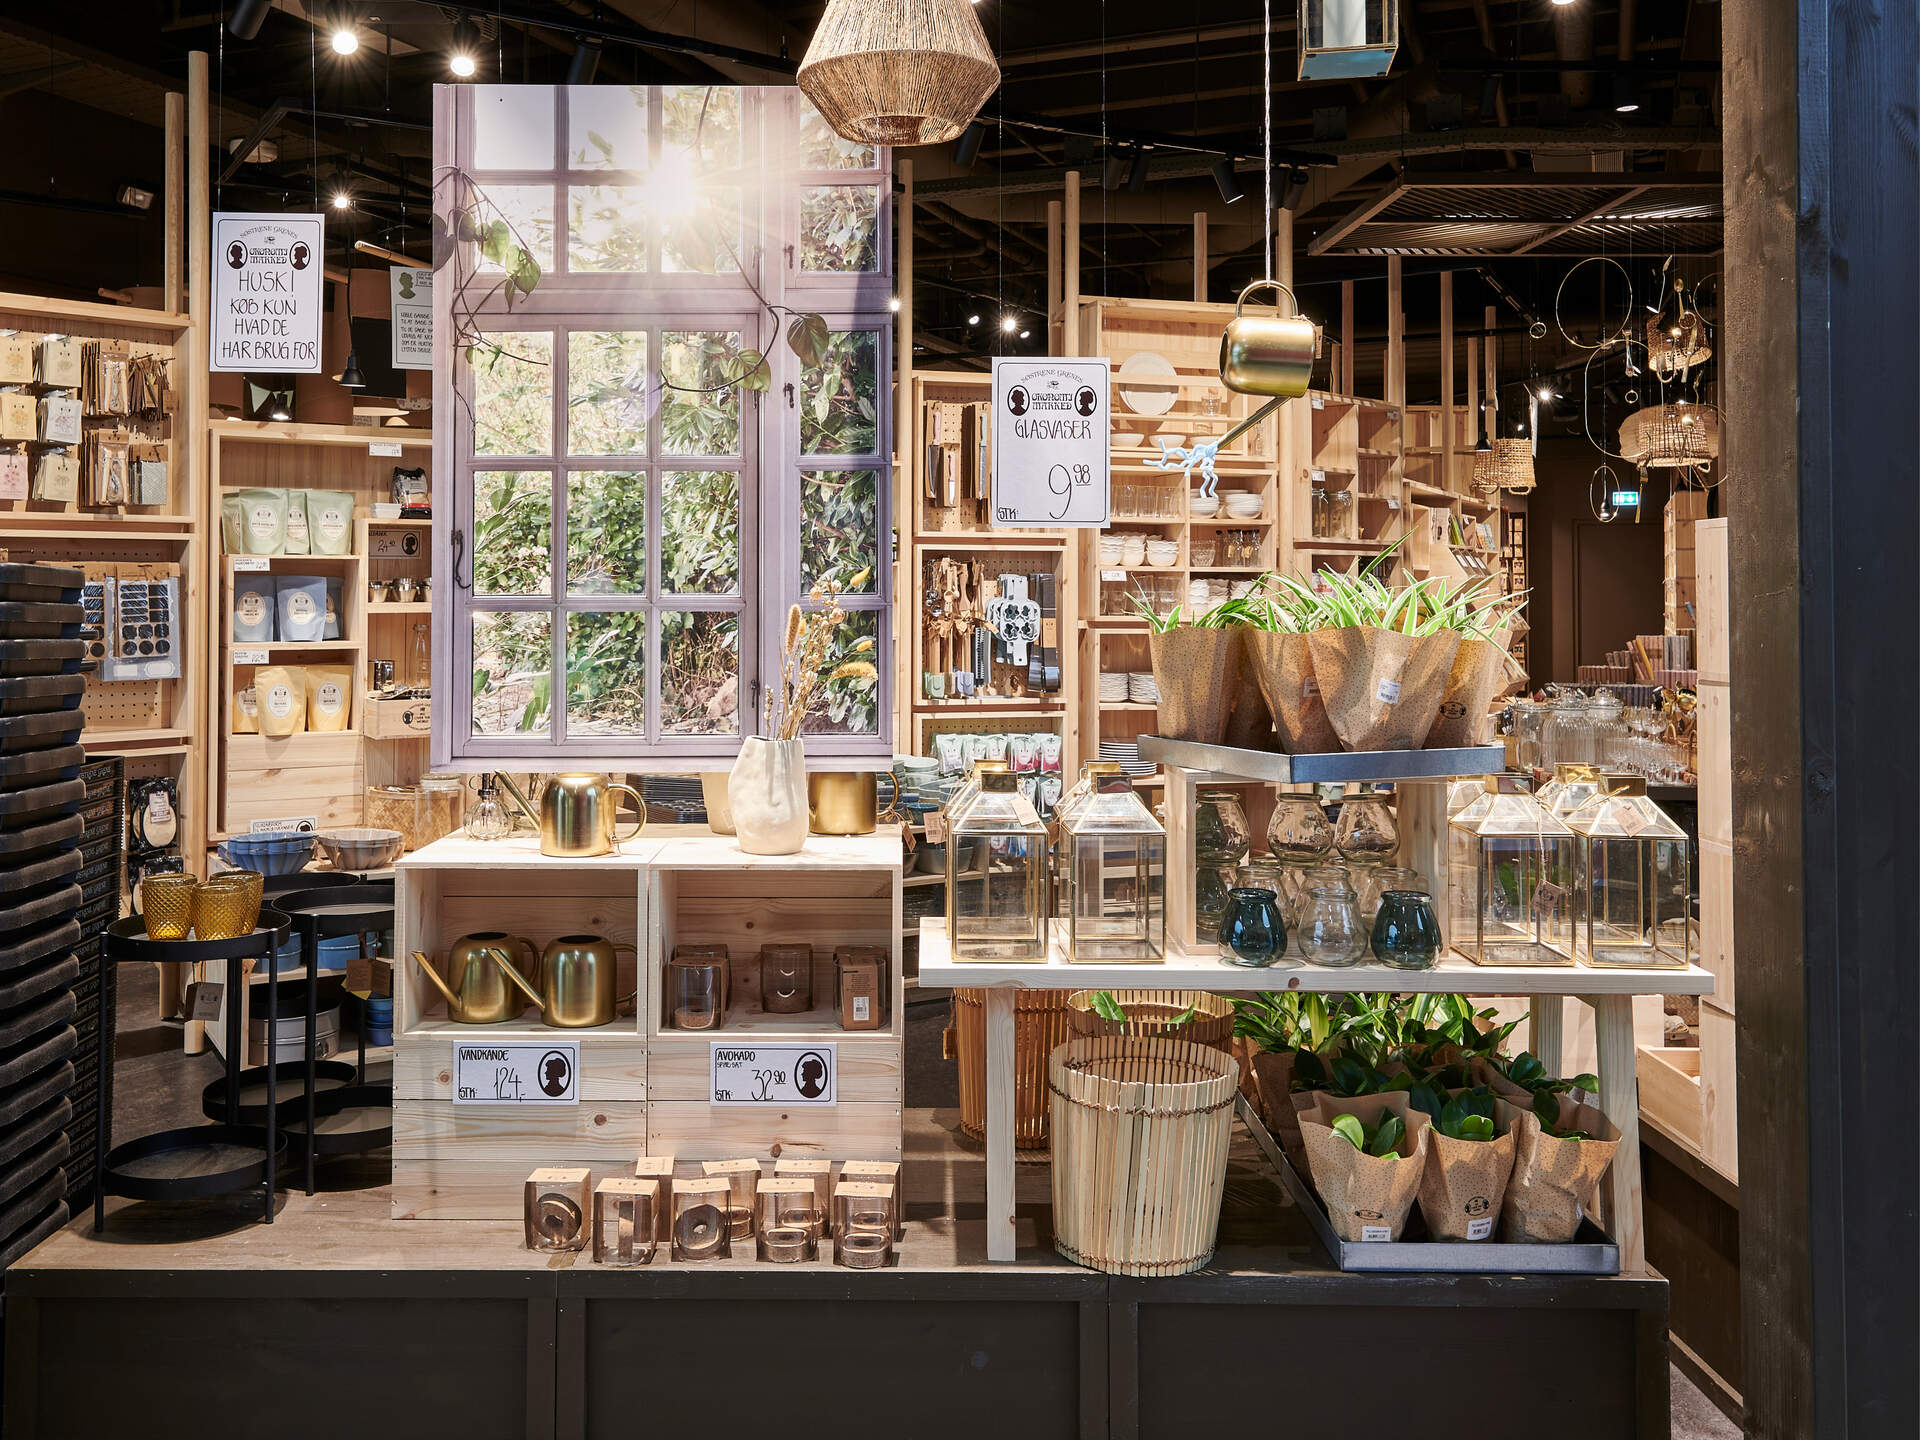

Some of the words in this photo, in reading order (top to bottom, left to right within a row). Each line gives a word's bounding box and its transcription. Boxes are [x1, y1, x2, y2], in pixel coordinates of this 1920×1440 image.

[263, 299, 297, 316] KUN
[234, 318, 270, 336] HVAD
[272, 319, 290, 337] DE
[222, 341, 251, 359] HAR
[254, 341, 290, 360] BRUG
[293, 341, 316, 361] FOR
[1015, 418, 1092, 440] GLASVASER
[460, 1049, 510, 1061] VANDKANDE
[717, 1050, 756, 1062] AVOKADO
